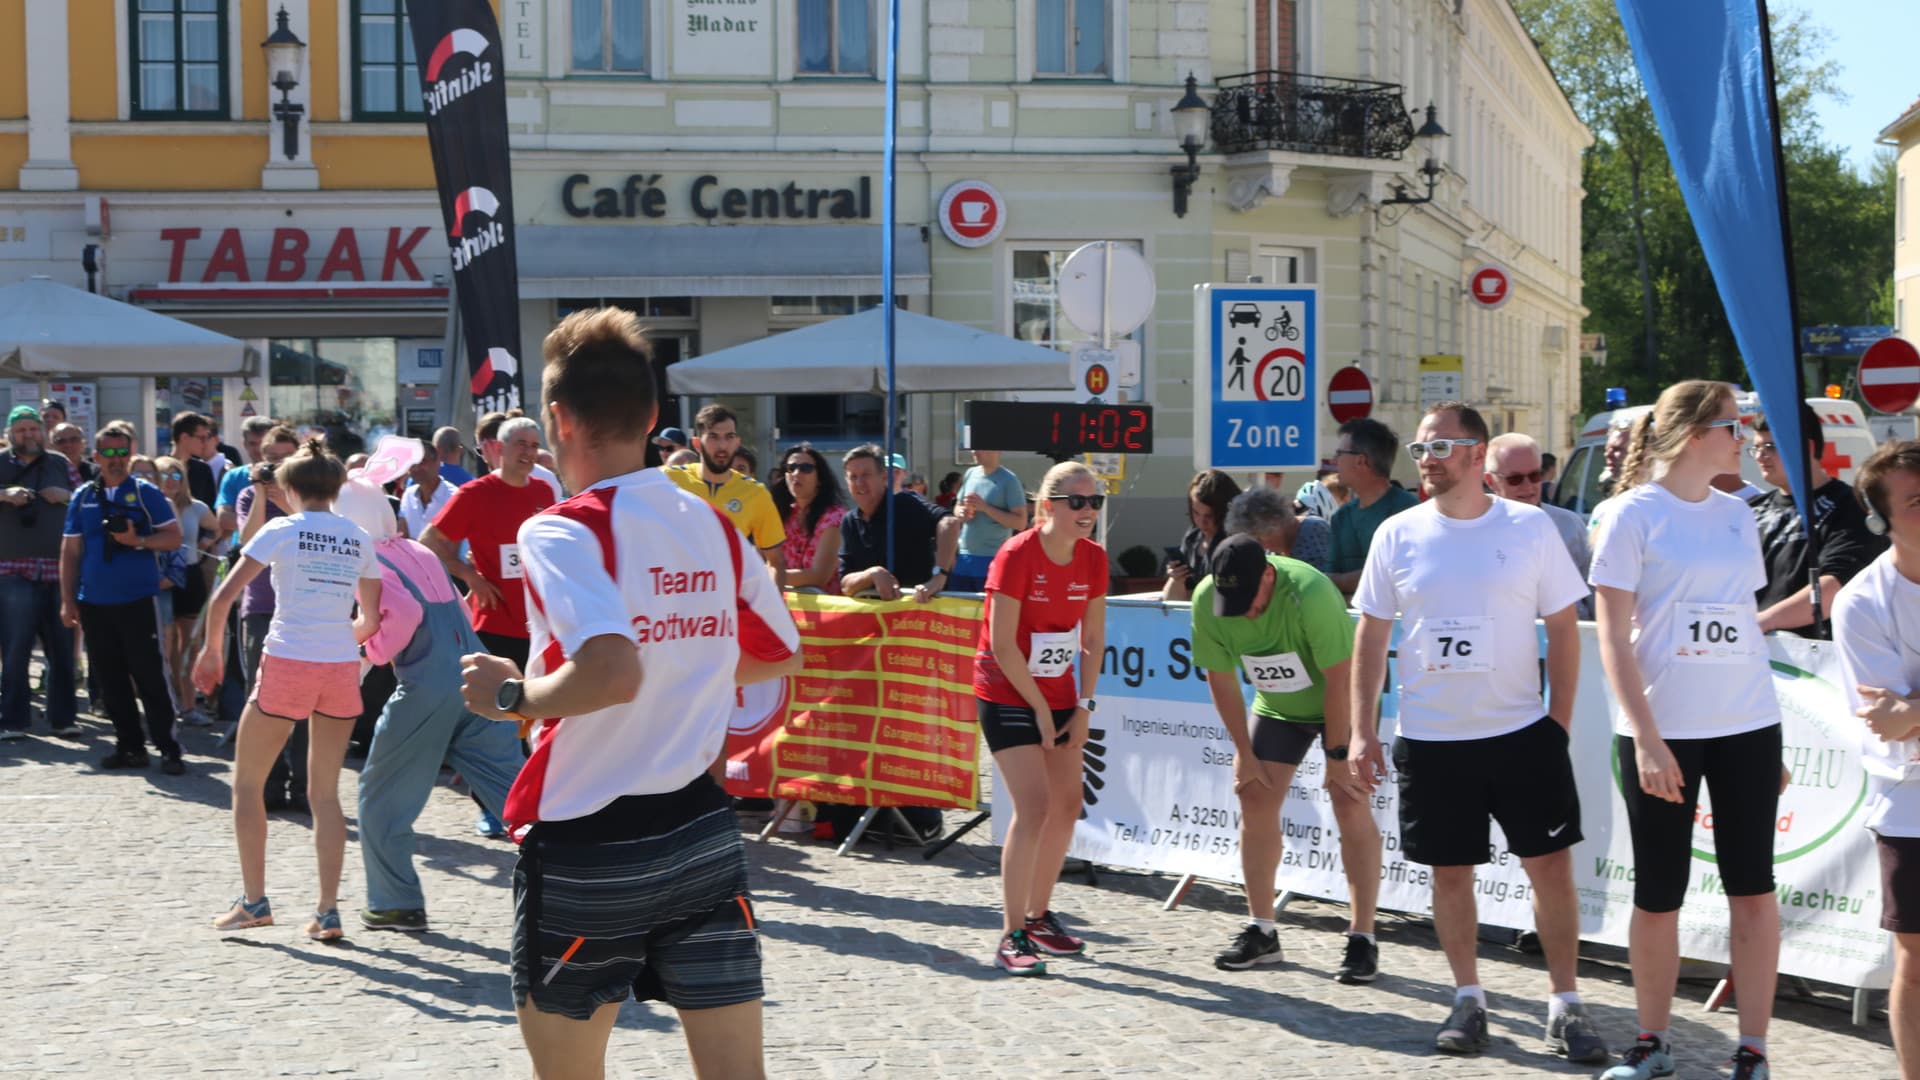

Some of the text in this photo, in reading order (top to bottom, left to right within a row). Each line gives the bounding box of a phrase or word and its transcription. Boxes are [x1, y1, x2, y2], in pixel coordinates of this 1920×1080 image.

[687, 14, 758, 37] Madar
[561, 173, 871, 219] Café Central
[160, 226, 432, 284] TABAK
[1090, 370, 1104, 389] H
[1270, 366, 1301, 397] 20
[1051, 409, 1147, 449] 11:02
[1228, 418, 1300, 449] Zone
[299, 531, 361, 547] FRESH AIR
[299, 541, 361, 558] BEST FLAIR
[509, 553, 523, 567] 3
[648, 566, 717, 596] Team
[1688, 620, 1739, 644] 10c
[1038, 647, 1073, 665] 23c
[1437, 636, 1473, 657] 7c
[1253, 665, 1296, 681] 22b
[1122, 714, 1234, 748] Ingenieurkonsul
[1201, 746, 1233, 767] Staa
[1169, 803, 1228, 830] A-3250
